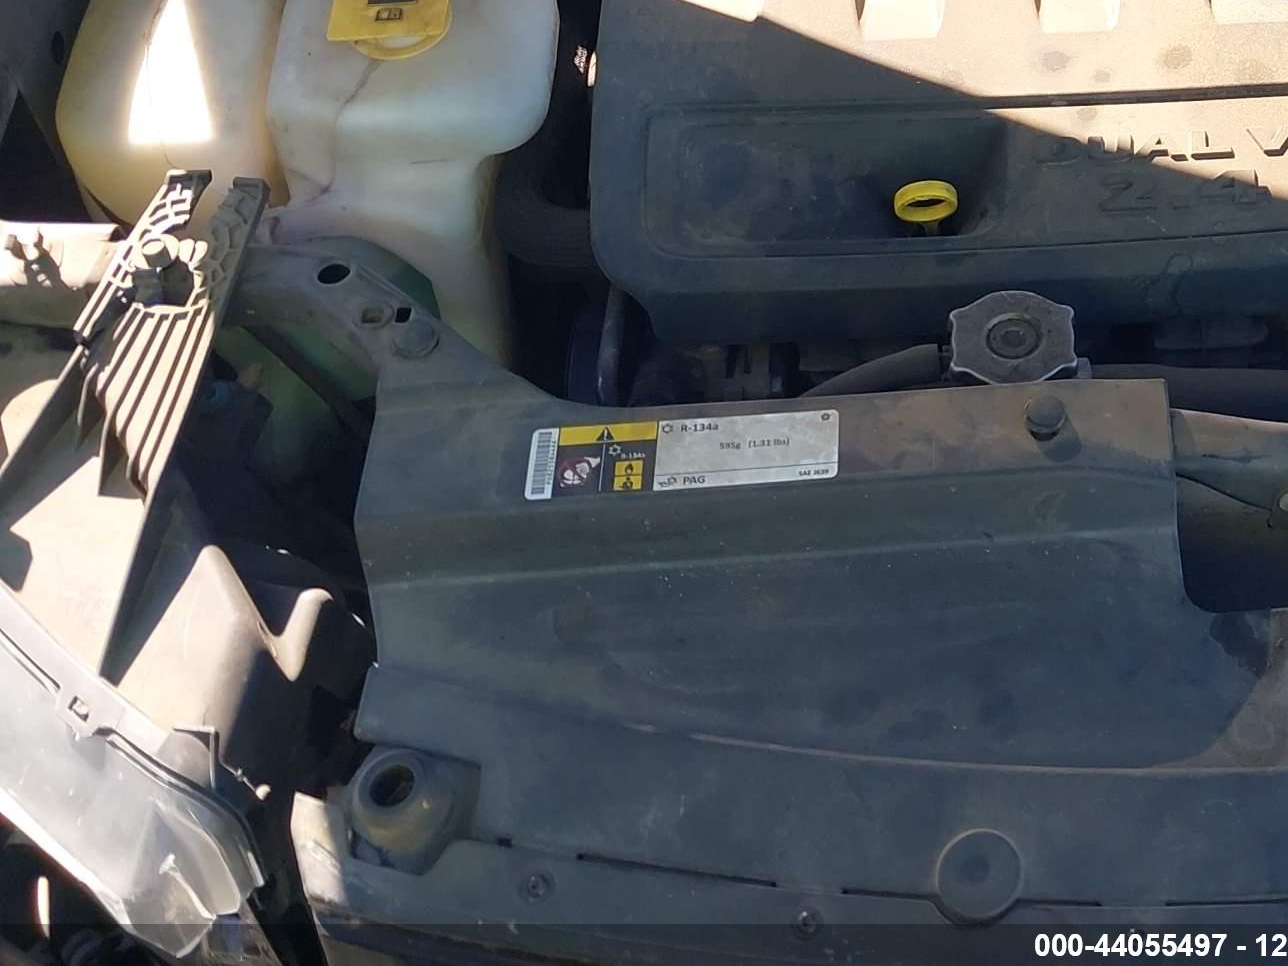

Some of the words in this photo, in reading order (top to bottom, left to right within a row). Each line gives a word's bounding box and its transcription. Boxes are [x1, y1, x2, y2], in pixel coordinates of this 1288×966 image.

[1036, 130, 1236, 164] DUAL
[679, 422, 719, 434] R-134a
[681, 474, 707, 485] PAG
